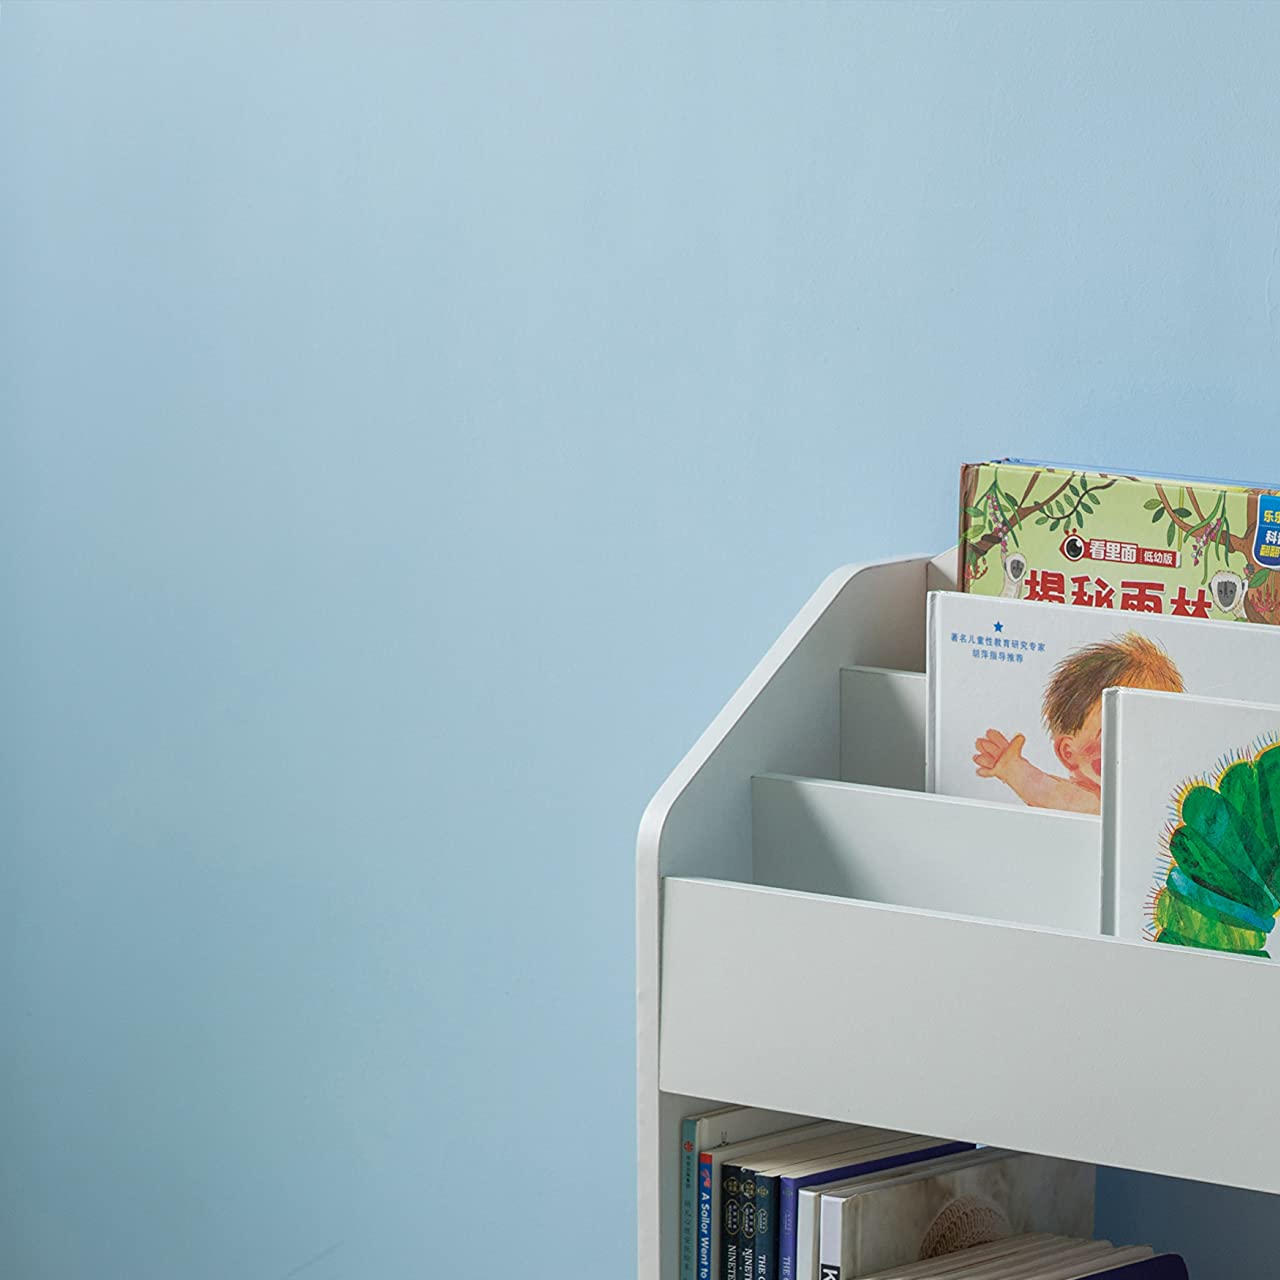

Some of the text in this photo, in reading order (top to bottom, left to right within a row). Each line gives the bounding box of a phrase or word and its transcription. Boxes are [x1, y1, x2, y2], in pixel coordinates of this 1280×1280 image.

[1089, 541, 1173, 565] 看里面 低幼版
[1024, 569, 1213, 619] 揭秘雨林
[701, 1192, 710, 1201] A
[701, 1203, 711, 1234] Sailor
[700, 1238, 710, 1265] Went
[700, 1267, 709, 1279] to
[758, 1254, 767, 1275] THE
